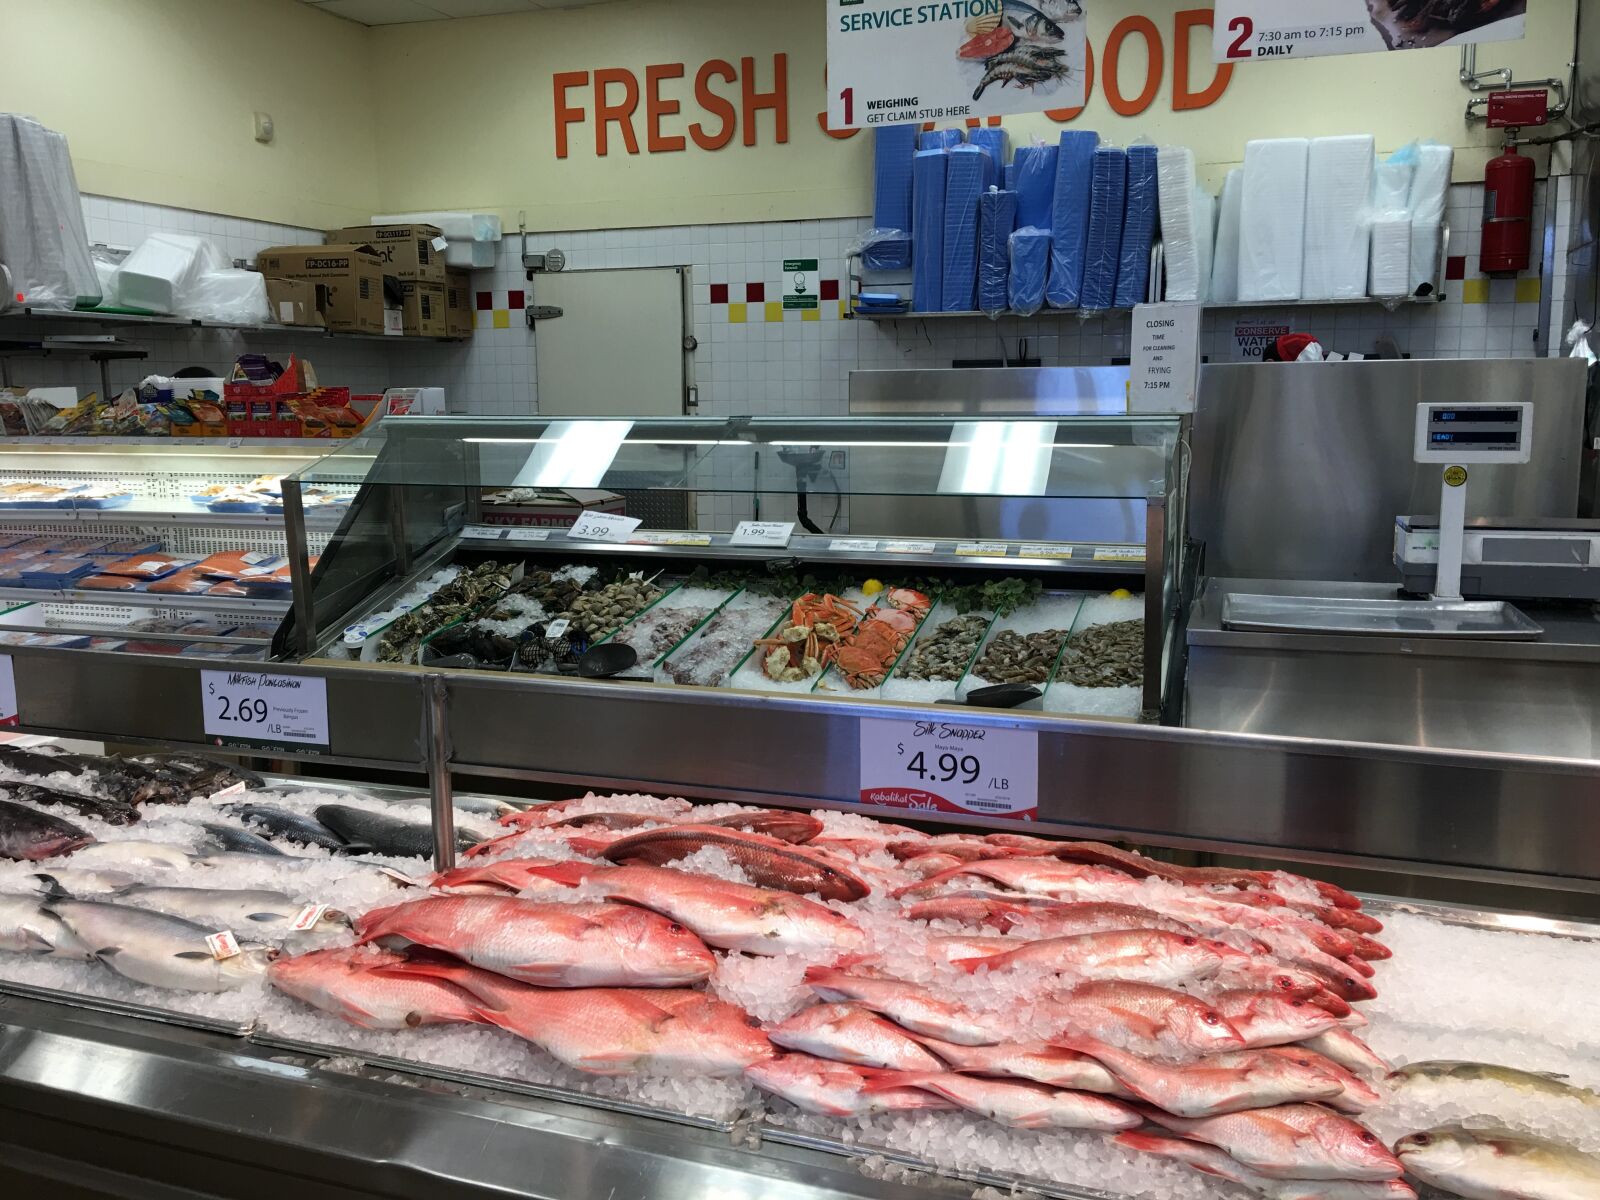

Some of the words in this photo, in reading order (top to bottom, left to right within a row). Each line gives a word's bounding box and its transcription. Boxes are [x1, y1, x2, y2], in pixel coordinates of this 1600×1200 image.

[840, 8, 913, 32] SERVICE
[917, 0, 999, 24] STATION
[1226, 16, 1253, 59] 2
[1258, 31, 1281, 42] 7:30
[1284, 32, 1302, 40] am
[1304, 29, 1316, 39] to
[1319, 26, 1342, 37] 7:15
[1346, 25, 1364, 37] pm
[1257, 44, 1294, 57] DAILY
[552, 52, 789, 159] FRESH
[839, 87, 854, 125] 1
[867, 97, 919, 110] WEIGHING
[867, 112, 886, 123] GET
[886, 110, 917, 122] CLAIM
[919, 107, 944, 120] STUB
[945, 105, 971, 117] HERE
[1146, 319, 1175, 328] CLOSING
[1236, 327, 1286, 336] CONSERVE
[1242, 346, 1264, 357] NO
[1148, 366, 1172, 374] FRYING
[1144, 381, 1158, 389] 7:15
[1159, 381, 1170, 389] PM
[578, 524, 609, 537] 3.99
[742, 528, 765, 536] 1.99
[209, 682, 215, 695] $
[218, 696, 268, 723] 2.69
[267, 723, 282, 734] /LB
[913, 720, 936, 737] Silk
[897, 742, 905, 755] $
[907, 751, 981, 784] 4.99
[988, 777, 1009, 790] /LB
[870, 792, 909, 806] Kabalikat
[908, 793, 938, 811] Sale
